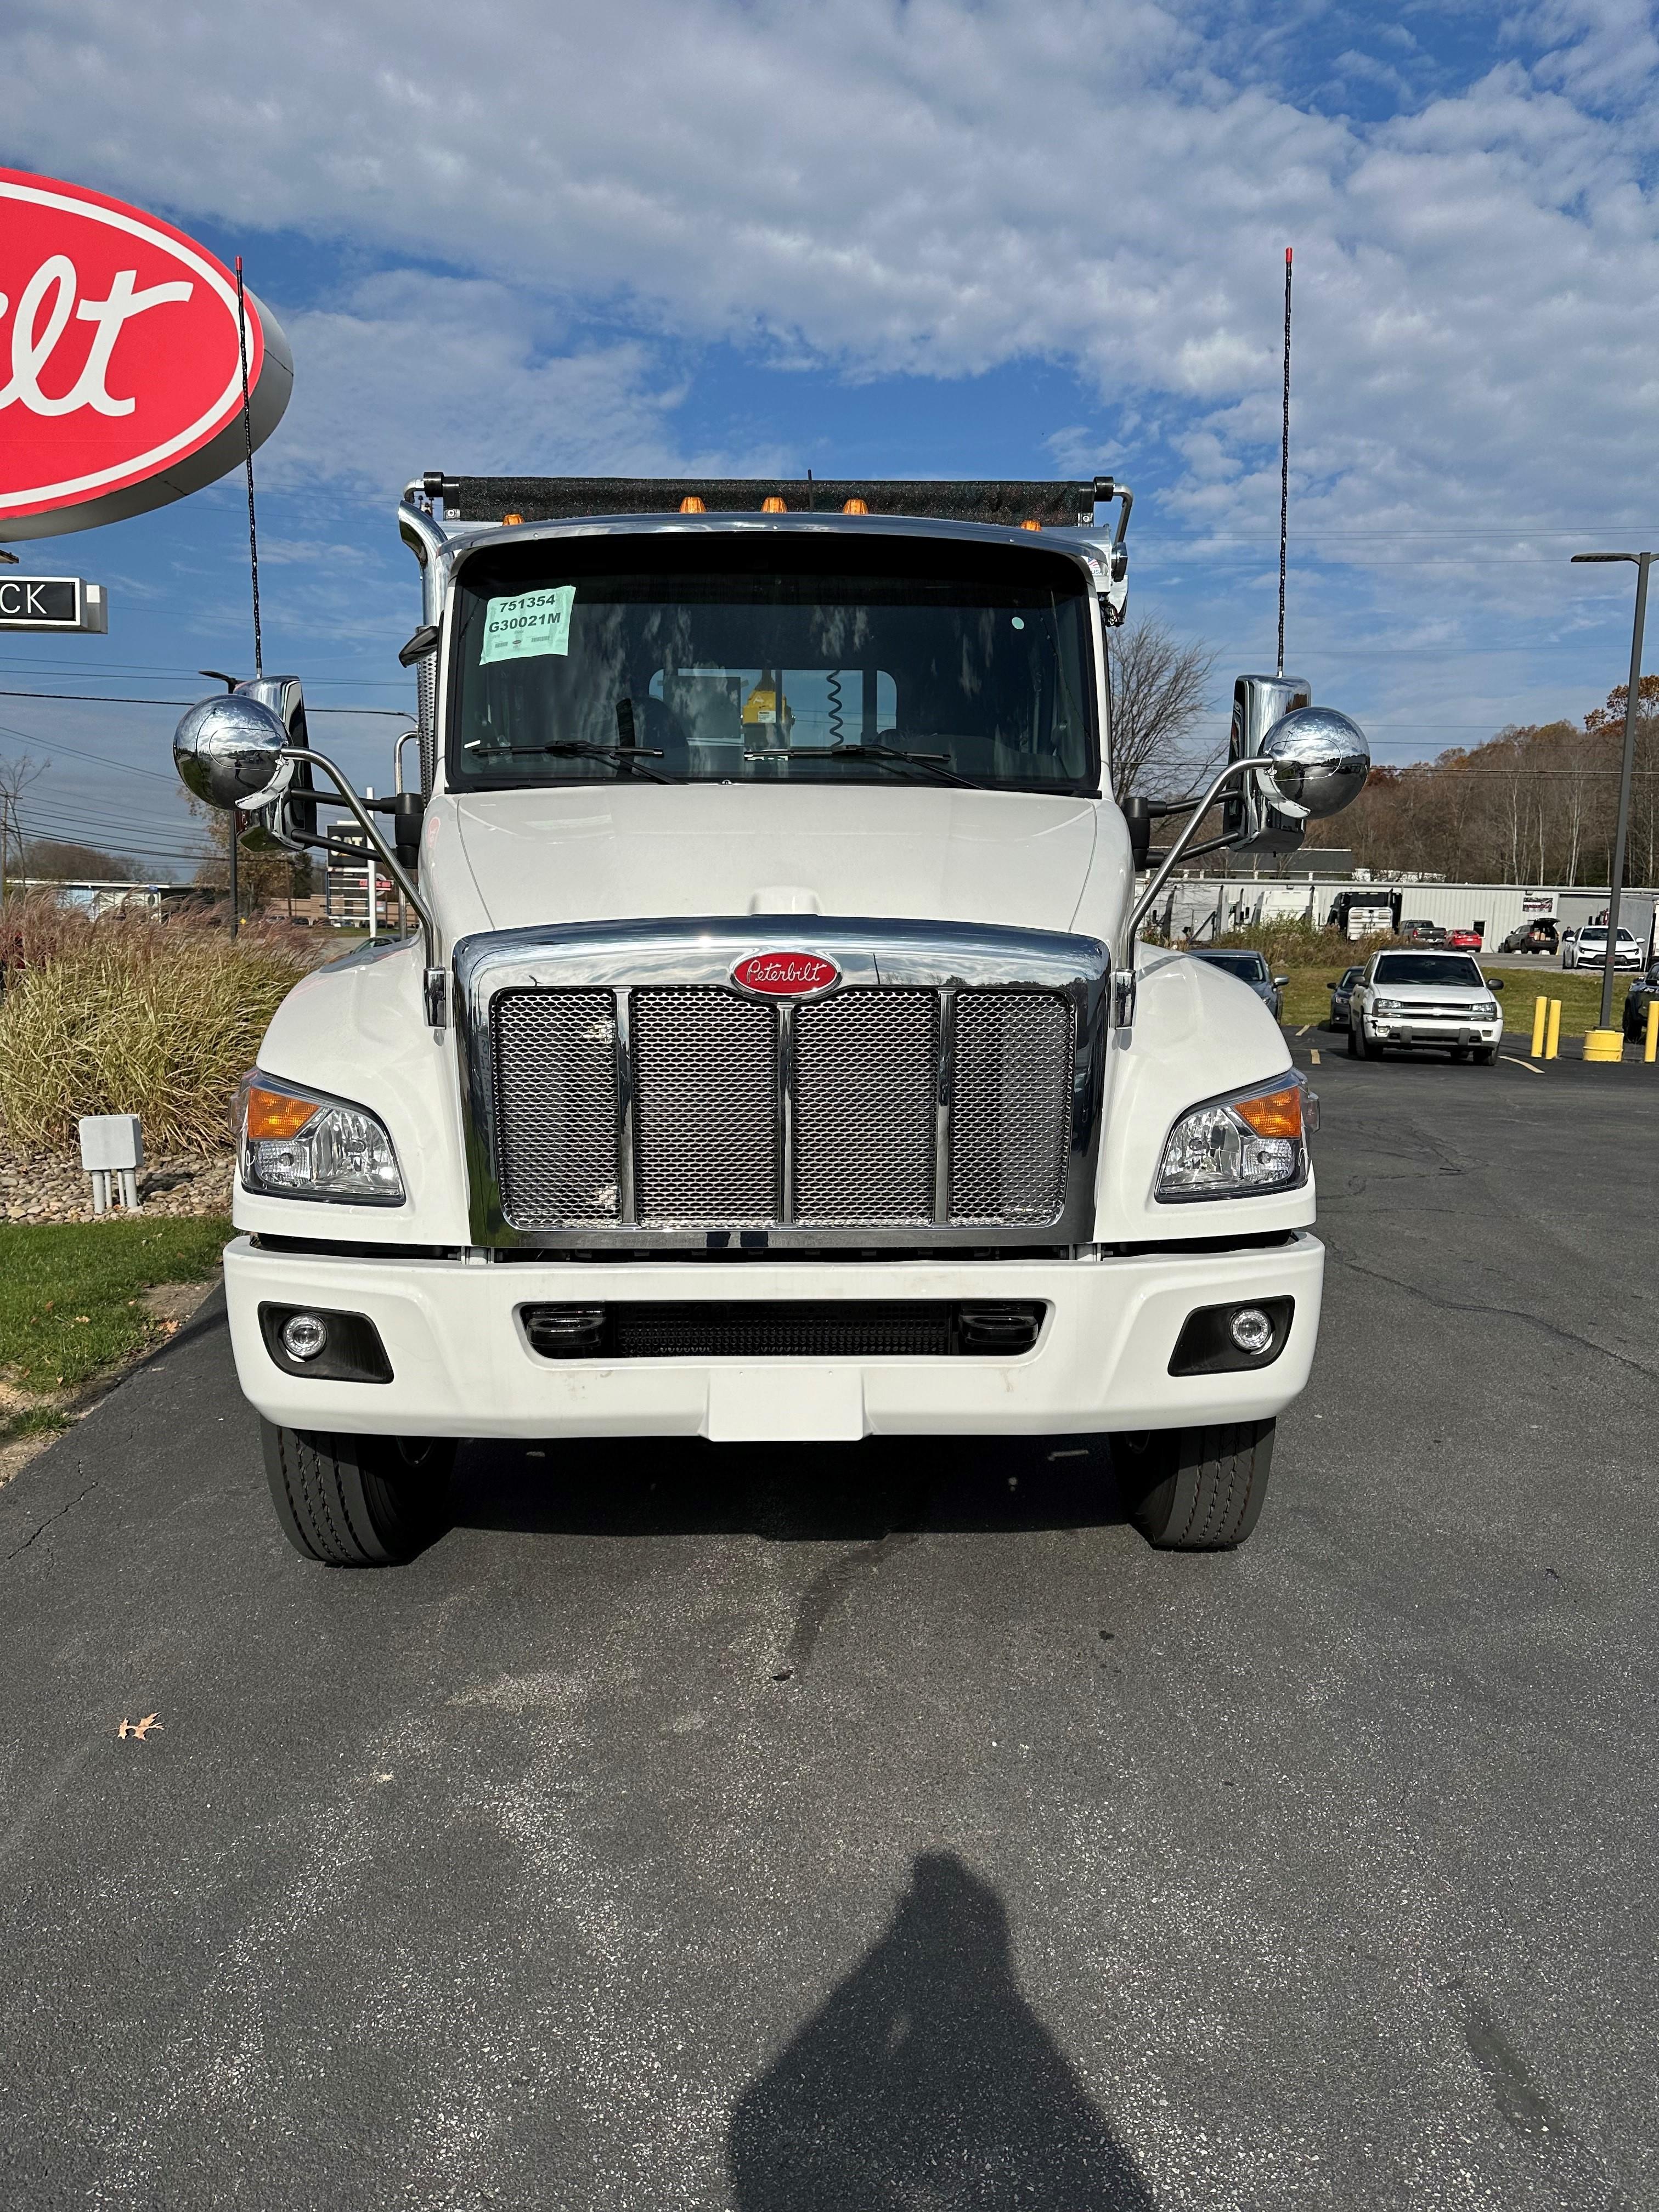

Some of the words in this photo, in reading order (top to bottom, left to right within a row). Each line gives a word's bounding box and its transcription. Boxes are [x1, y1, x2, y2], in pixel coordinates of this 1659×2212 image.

[0, 254, 194, 417] lt
[0, 583, 47, 614] CK
[500, 594, 555, 613] 751354
[489, 612, 561, 633] G30021M
[746, 960, 827, 984] Peterbilt
